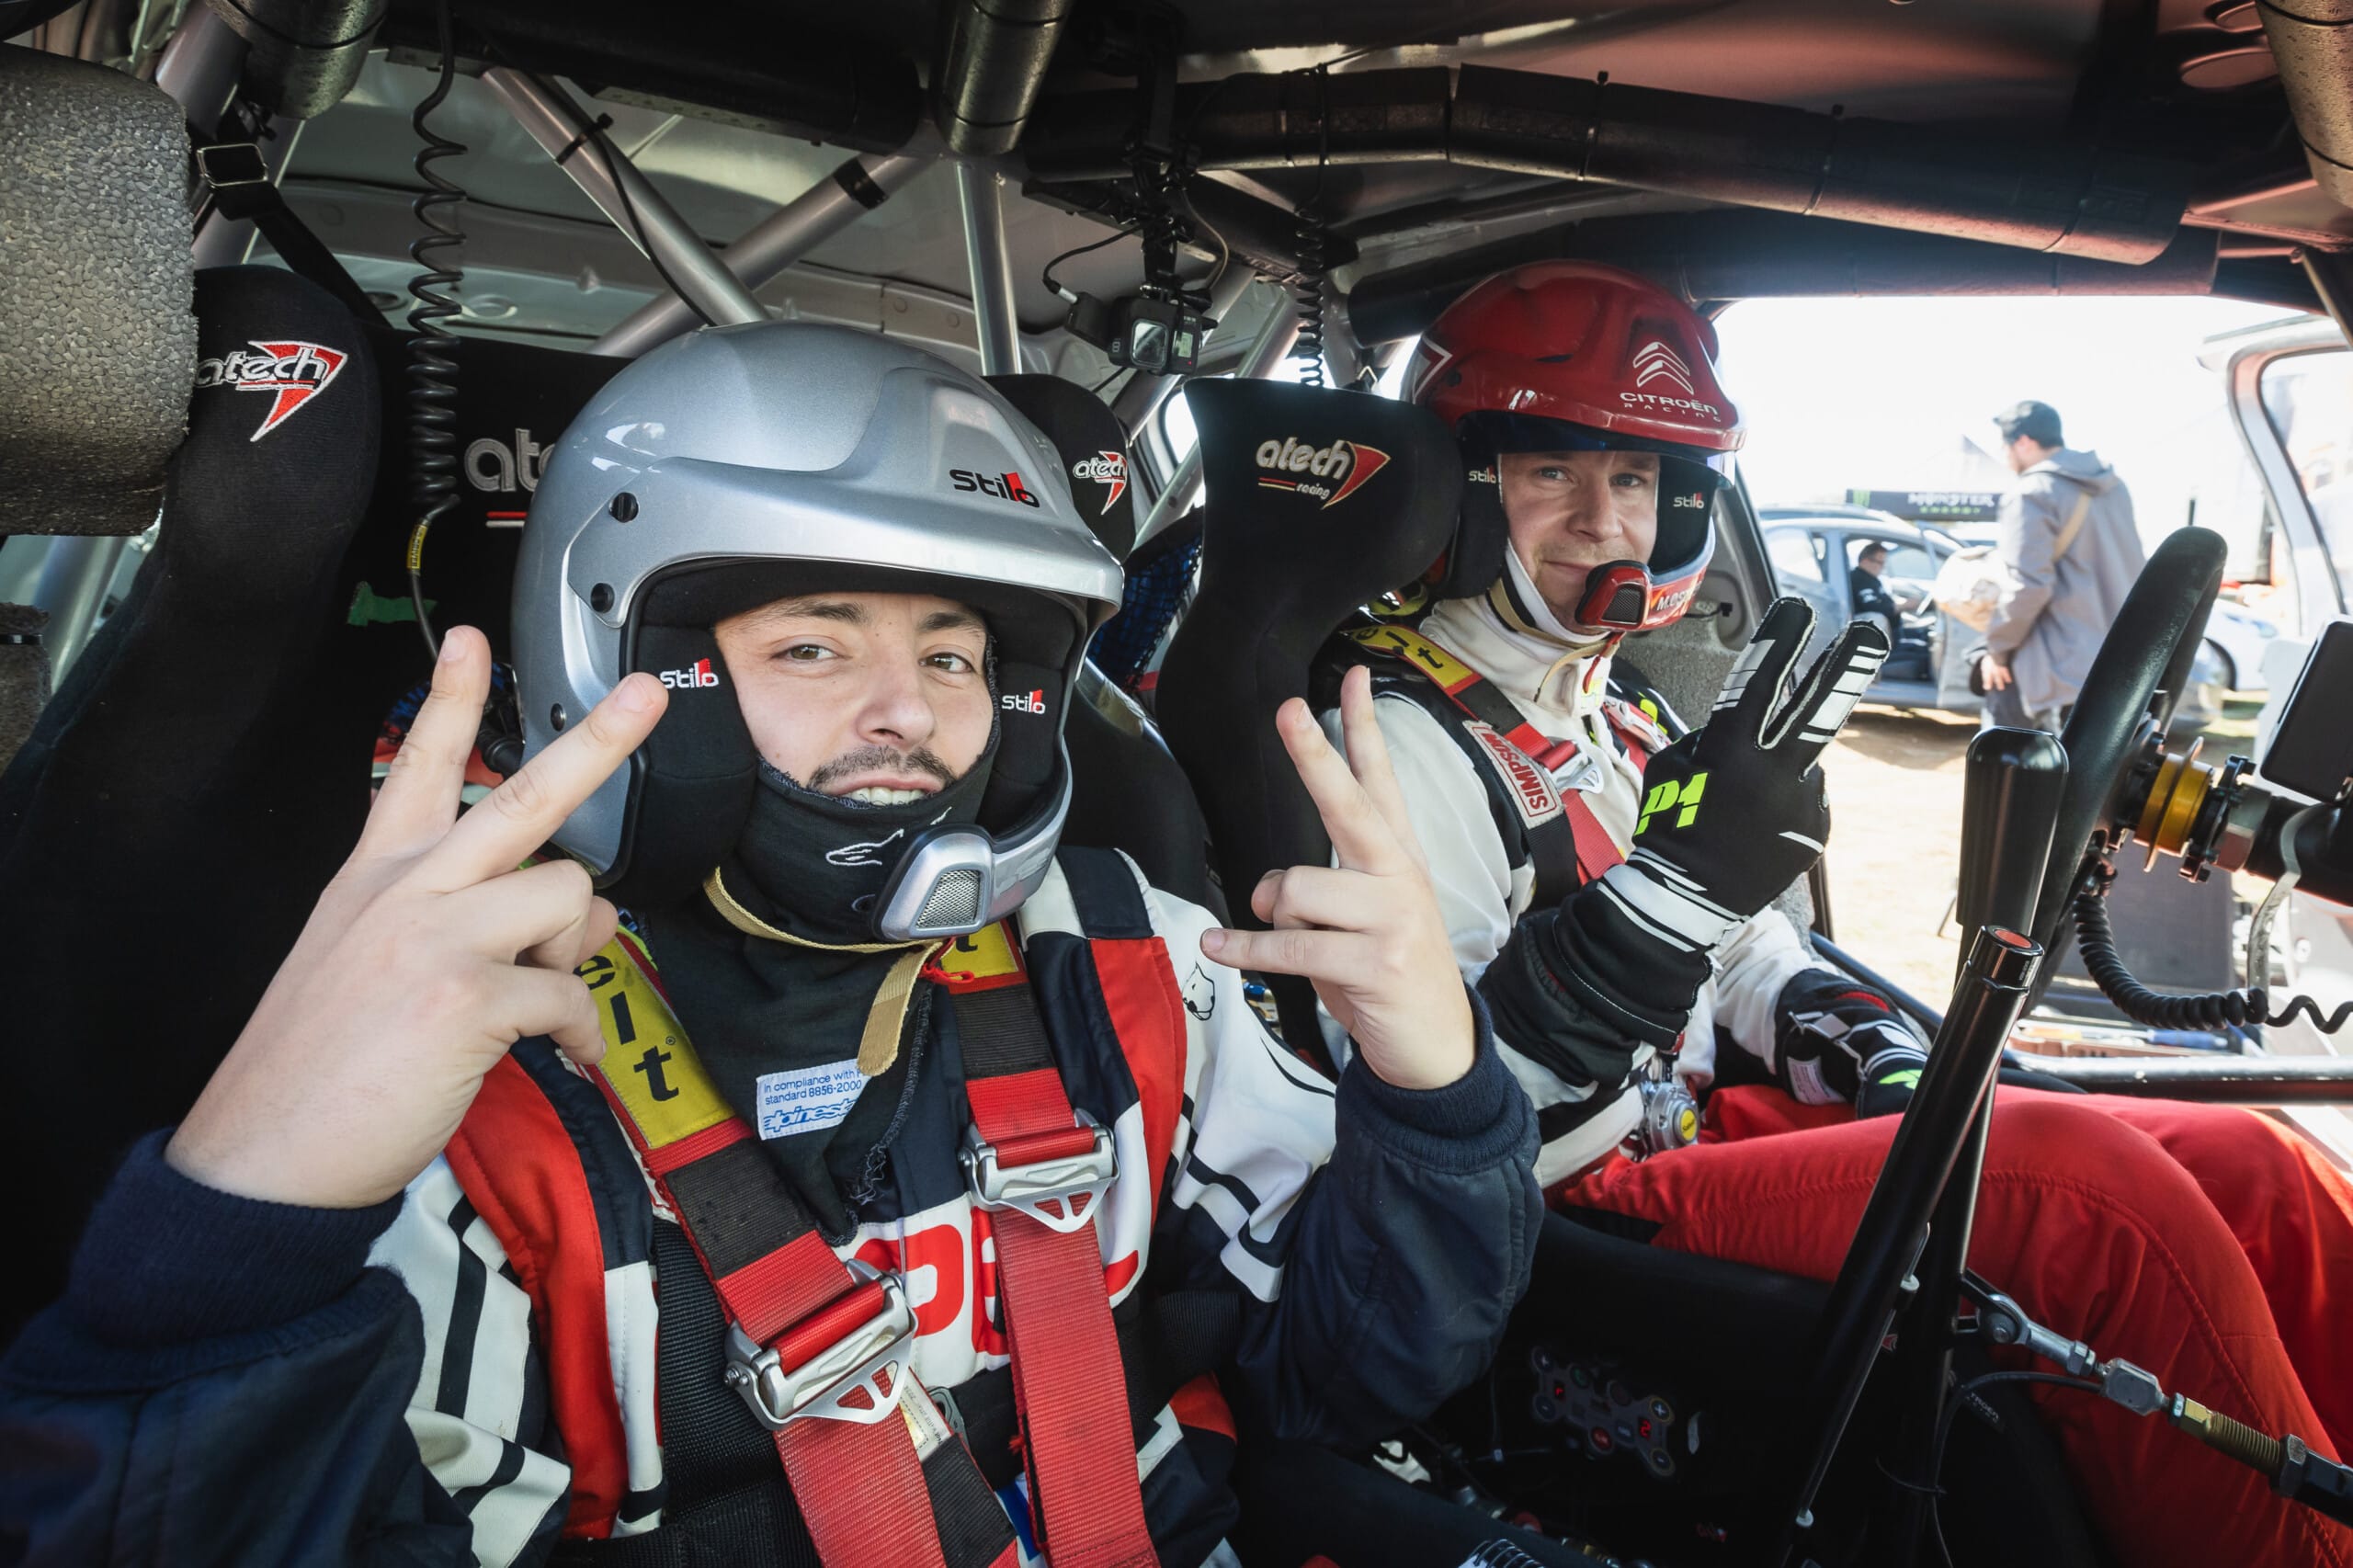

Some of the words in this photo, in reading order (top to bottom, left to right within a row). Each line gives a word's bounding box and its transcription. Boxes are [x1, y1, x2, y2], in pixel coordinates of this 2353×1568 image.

[464, 427, 555, 492] at
[1073, 457, 1127, 480] atech
[1256, 437, 1350, 480] atech
[1296, 483, 1330, 500] racing
[659, 660, 720, 689] stilo
[1001, 690, 1046, 714] stilo
[1633, 772, 1709, 836] P1
[765, 1088, 807, 1106] standard
[808, 1079, 862, 1097] 8856-2000
[773, 1074, 831, 1092] compliance
[834, 1070, 855, 1081] with
